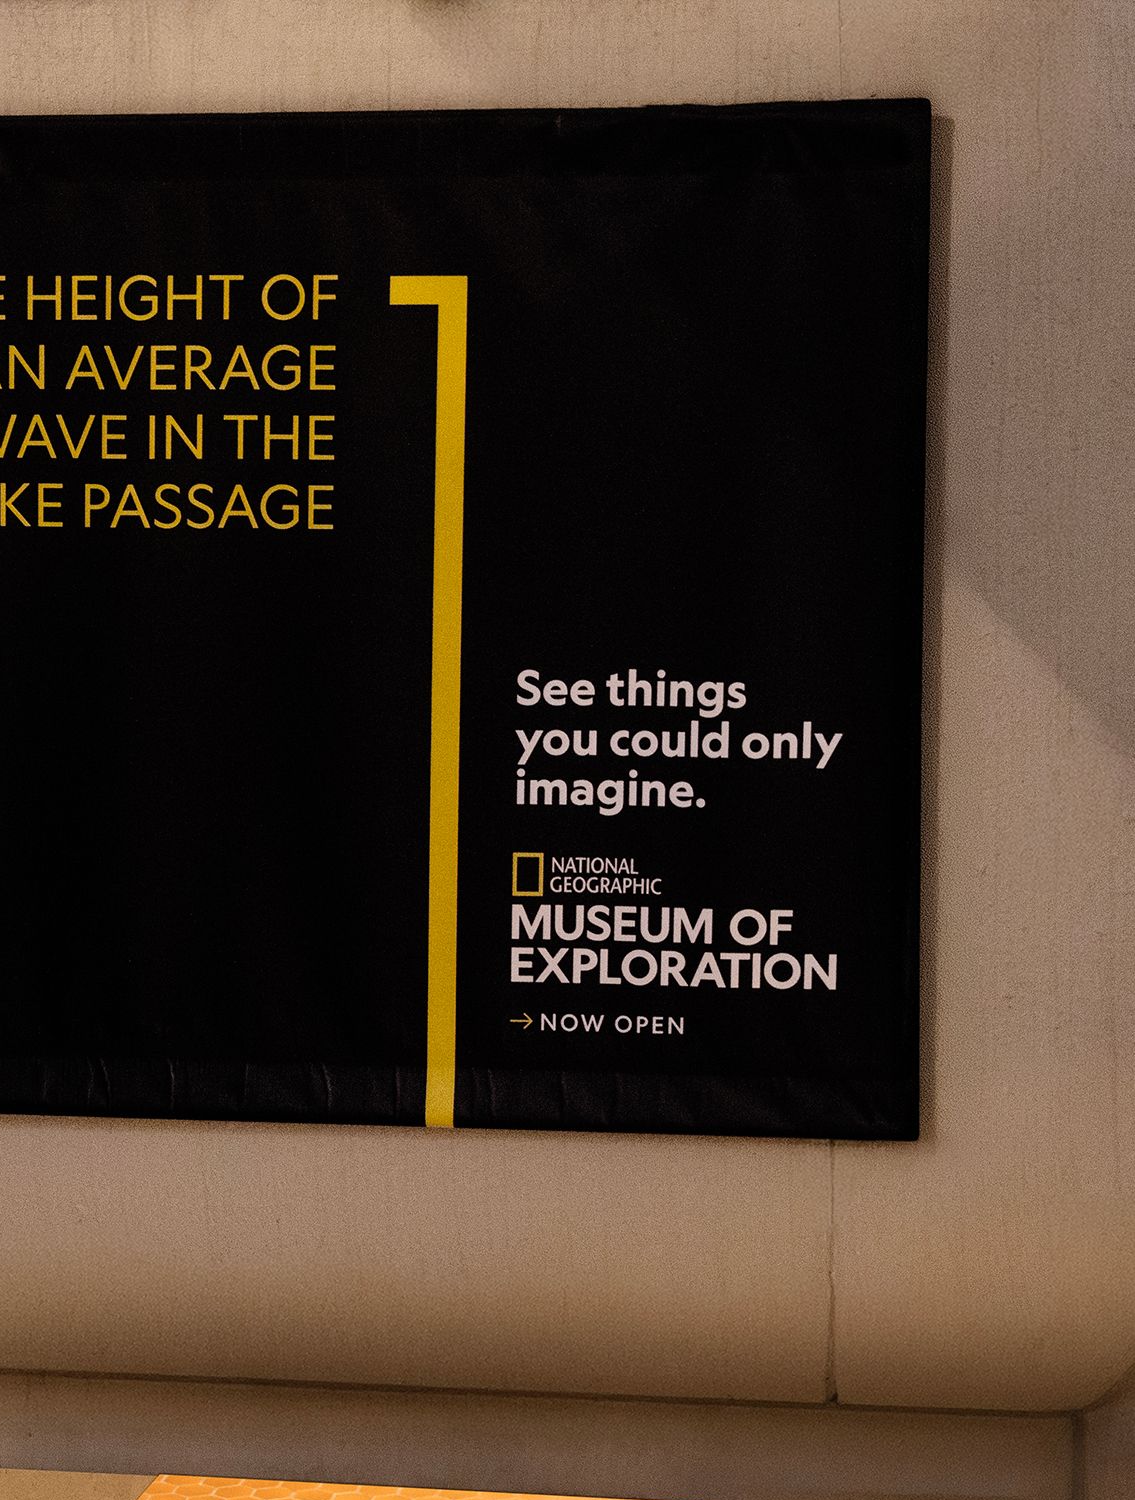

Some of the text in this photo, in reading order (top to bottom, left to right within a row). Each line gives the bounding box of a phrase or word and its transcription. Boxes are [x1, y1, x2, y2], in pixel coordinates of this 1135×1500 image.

[27, 275, 244, 321] HEIGHT
[262, 274, 338, 320] OF
[65, 344, 336, 391] AVERAGE
[149, 414, 203, 459] IN
[223, 415, 335, 460] THE
[85, 484, 334, 529] PASSAGE
[517, 669, 746, 718] See things
[515, 720, 843, 769] you could only
[517, 768, 705, 816] imagine.
[550, 876, 662, 895] GEOGRAPHIC
[552, 857, 638, 874] NATIONAL
[512, 904, 793, 945] MUSEUM OF
[511, 947, 837, 990] EXPLORATION
[541, 1013, 684, 1034] NOW OPEN
